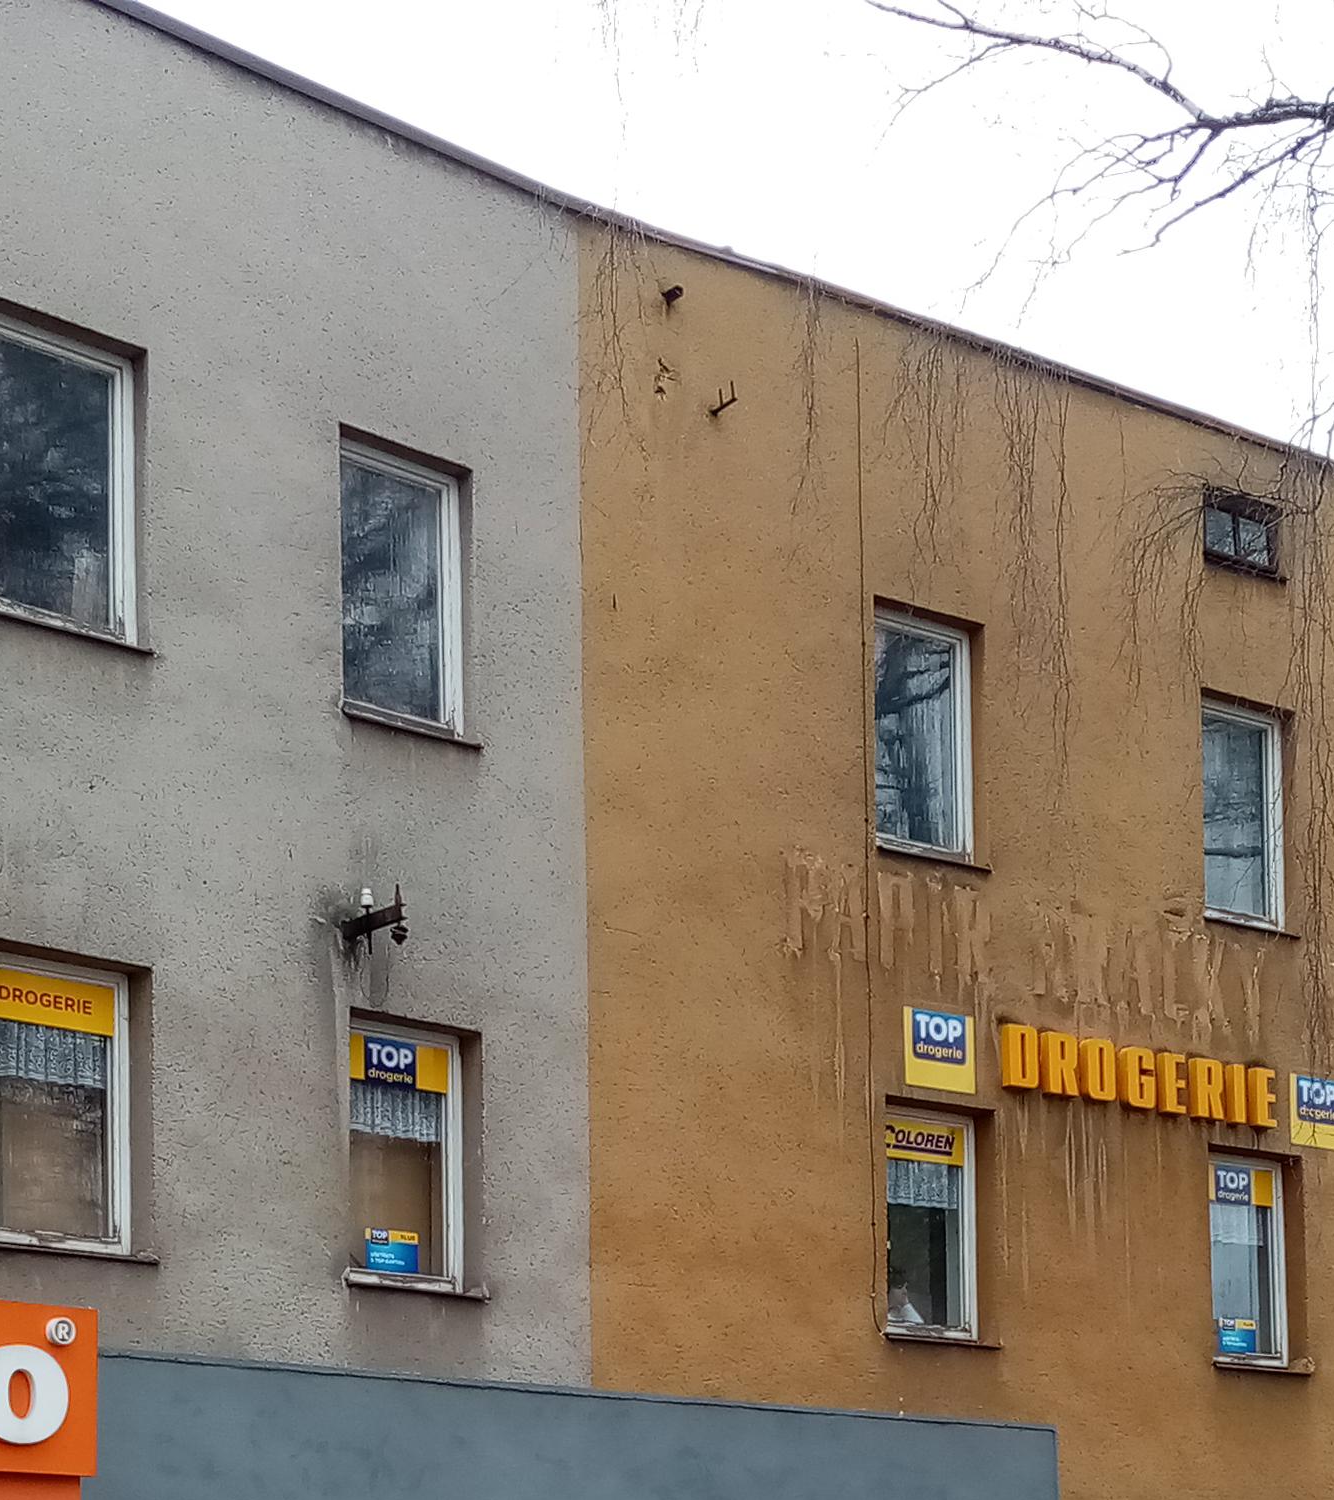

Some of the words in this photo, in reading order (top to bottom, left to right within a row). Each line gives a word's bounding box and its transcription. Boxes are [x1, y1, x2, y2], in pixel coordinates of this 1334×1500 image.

[914, 1013, 962, 1043] TOP
[367, 1043, 414, 1070] TOP
[916, 1041, 963, 1059] drogerie
[368, 1067, 413, 1084] drogerie
[1001, 1023, 1277, 1128] DROGERIE
[1217, 1170, 1249, 1190] TOP
[1217, 1190, 1249, 1202] drogerie
